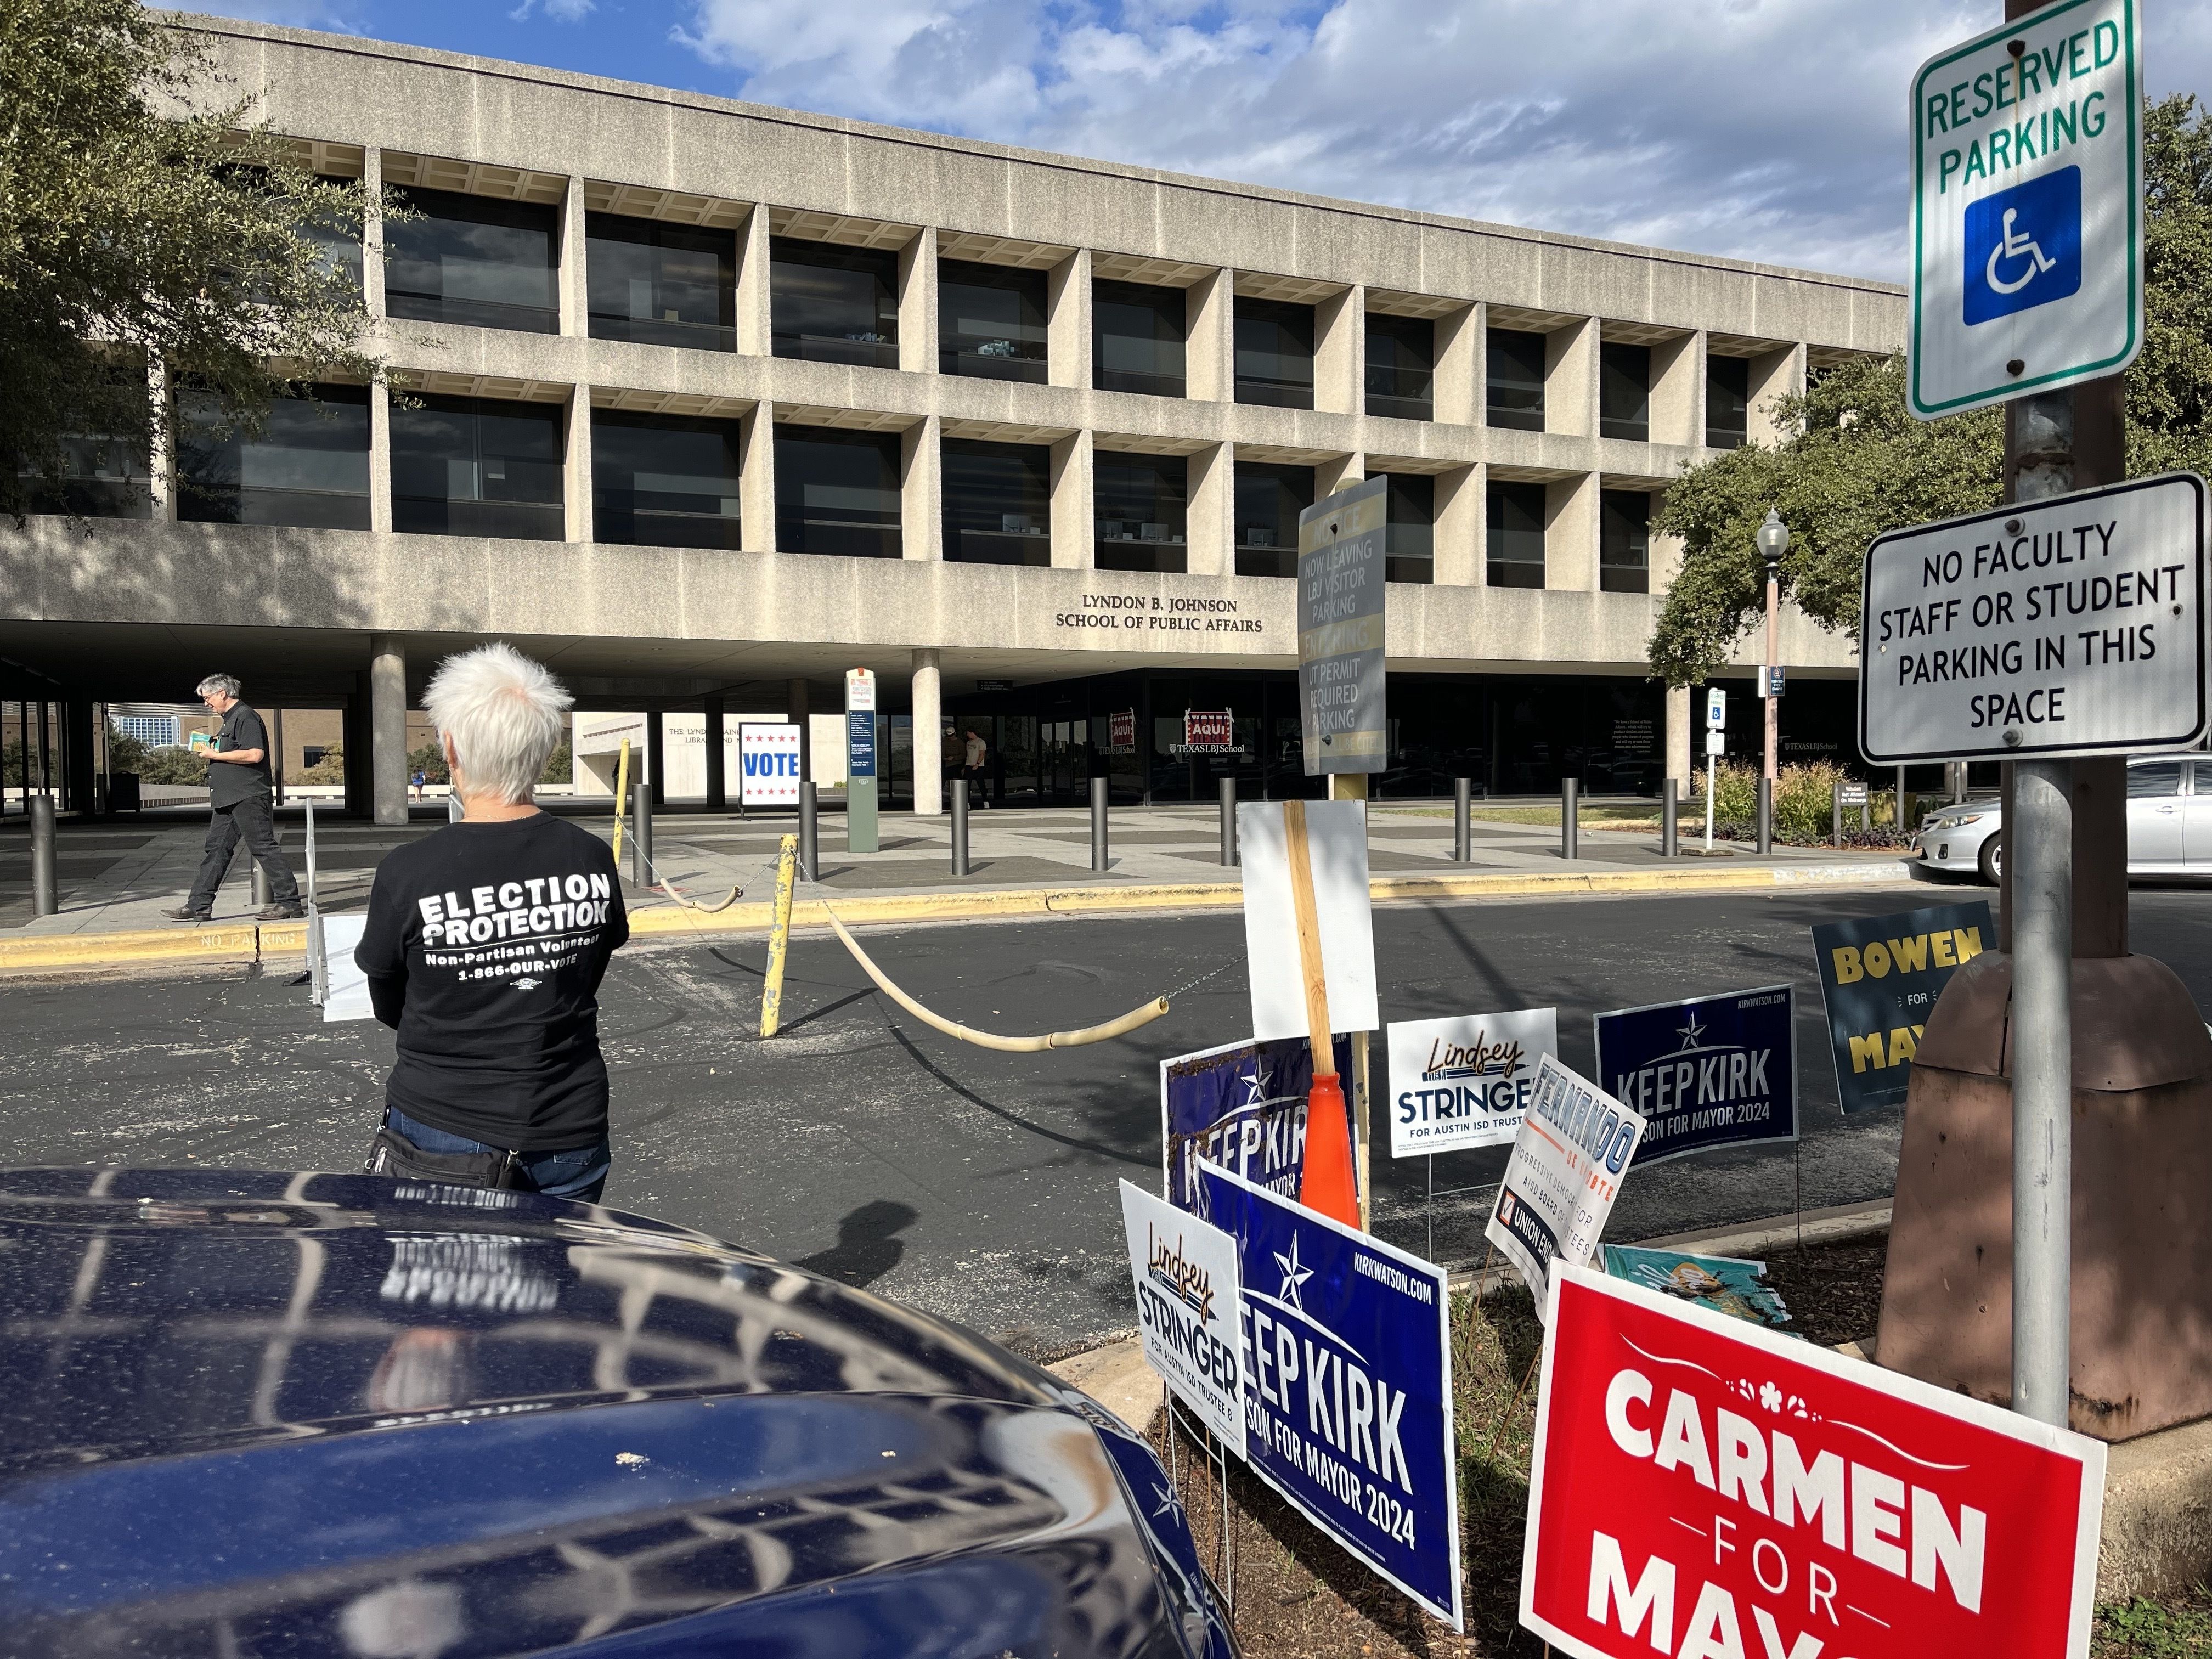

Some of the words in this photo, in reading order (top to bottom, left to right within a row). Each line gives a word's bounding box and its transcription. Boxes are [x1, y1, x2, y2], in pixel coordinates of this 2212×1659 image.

[1927, 19, 2119, 139] RESERVED
[1940, 91, 2106, 194] PARKING
[1313, 506, 1361, 546] NOTICE
[1305, 552, 1324, 579] NOW
[1327, 539, 1372, 571] LEAVING
[1923, 550, 1962, 588] NO
[1974, 521, 2117, 578] FACULTY
[1082, 595, 1146, 610] LYNDON
[1152, 597, 1164, 610] B.
[1169, 598, 1238, 613] JOHNSON
[1308, 582, 1322, 602] LBJ
[1325, 567, 1365, 596] VISITOR
[1880, 599, 1961, 641] STAFF
[1973, 591, 2015, 627] OR
[2026, 564, 2185, 621] STUDENT
[1056, 613, 1119, 628] SCHOOL
[1124, 616, 1143, 629] OF
[1149, 617, 1200, 630] PUBLIC
[1205, 619, 1262, 633] AFFAIRS
[1313, 594, 1356, 624] PARKING
[1305, 621, 1369, 659] ENTRING
[1899, 641, 2023, 686] PARKING
[2036, 635, 2066, 671] IN
[2078, 624, 2156, 665] THIS
[1309, 665, 1318, 685] UT
[1320, 658, 1361, 682] PERMIT
[1311, 684, 1358, 709] REQUIRED
[1971, 687, 2066, 729] SPACE
[1313, 708, 1355, 732] PARKING
[743, 753, 799, 776] VOTE
[1177, 744, 1205, 753] TEXAS
[1205, 744, 1219, 754] LBJ
[1220, 744, 1245, 753] School
[1357, 736, 1378, 751] CITE
[1810, 743, 1819, 751] LBJ
[418, 873, 610, 924] ELECTION
[201, 935, 221, 947] NO
[422, 900, 610, 945] PROTECTION
[426, 944, 535, 966] Non-Partisan
[540, 934, 600, 955] Volunteer
[458, 953, 578, 981] 1-866-OUR-VOTE
[1832, 926, 1983, 985] BOWEN
[1737, 994, 1785, 1009] KIRKWATSON.COM
[1908, 993, 1928, 1006] FOR
[1426, 1030, 1525, 1079] Lindsey
[1398, 1077, 1536, 1124] STRINGE
[1618, 1062, 1694, 1117] KEEP
[1698, 1049, 1771, 1105] KIRK
[1265, 1105, 1309, 1174] KIR
[1410, 1128, 1429, 1138] FOR
[1435, 1122, 1470, 1135] AUSTIN
[1474, 1121, 1489, 1130] ISD
[1493, 1116, 1523, 1128] TRUST
[1530, 1062, 1636, 1176] FERNANDO
[1638, 1122, 1663, 1144] SON
[1667, 1114, 1688, 1136] FOR
[1692, 1107, 1734, 1130] MAYOR
[1737, 1102, 1769, 1123] 2024
[1514, 1143, 1553, 1183] PROGRESSIVE
[1575, 1206, 1592, 1228] FOR
[1523, 1176, 1538, 1195] AISD
[1539, 1189, 1557, 1215] BOARD
[1514, 1206, 1541, 1248] UNION
[1149, 1220, 1214, 1326] Lindsey
[1354, 1252, 1432, 1305] KIRKWATSON.COM
[1139, 1280, 1239, 1404] STRINGER
[1151, 1336, 1163, 1356] FOR
[1164, 1349, 1184, 1378] AUSTIN
[1186, 1369, 1196, 1387] ISD
[1198, 1380, 1226, 1417] TRUSTEE
[1228, 1408, 1232, 1422] 8
[1239, 1296, 1299, 1414] EEP
[1305, 1338, 1413, 1496] KIRK
[1244, 1393, 1272, 1447] SON
[1275, 1419, 1304, 1472] FOR
[1306, 1441, 1363, 1516] MAYOR
[1366, 1484, 1416, 1551] 2024
[1605, 1368, 1987, 1615] CARMEN
[1715, 1513, 1839, 1627] FOR
[1587, 1530, 1859, 1659] MAY
